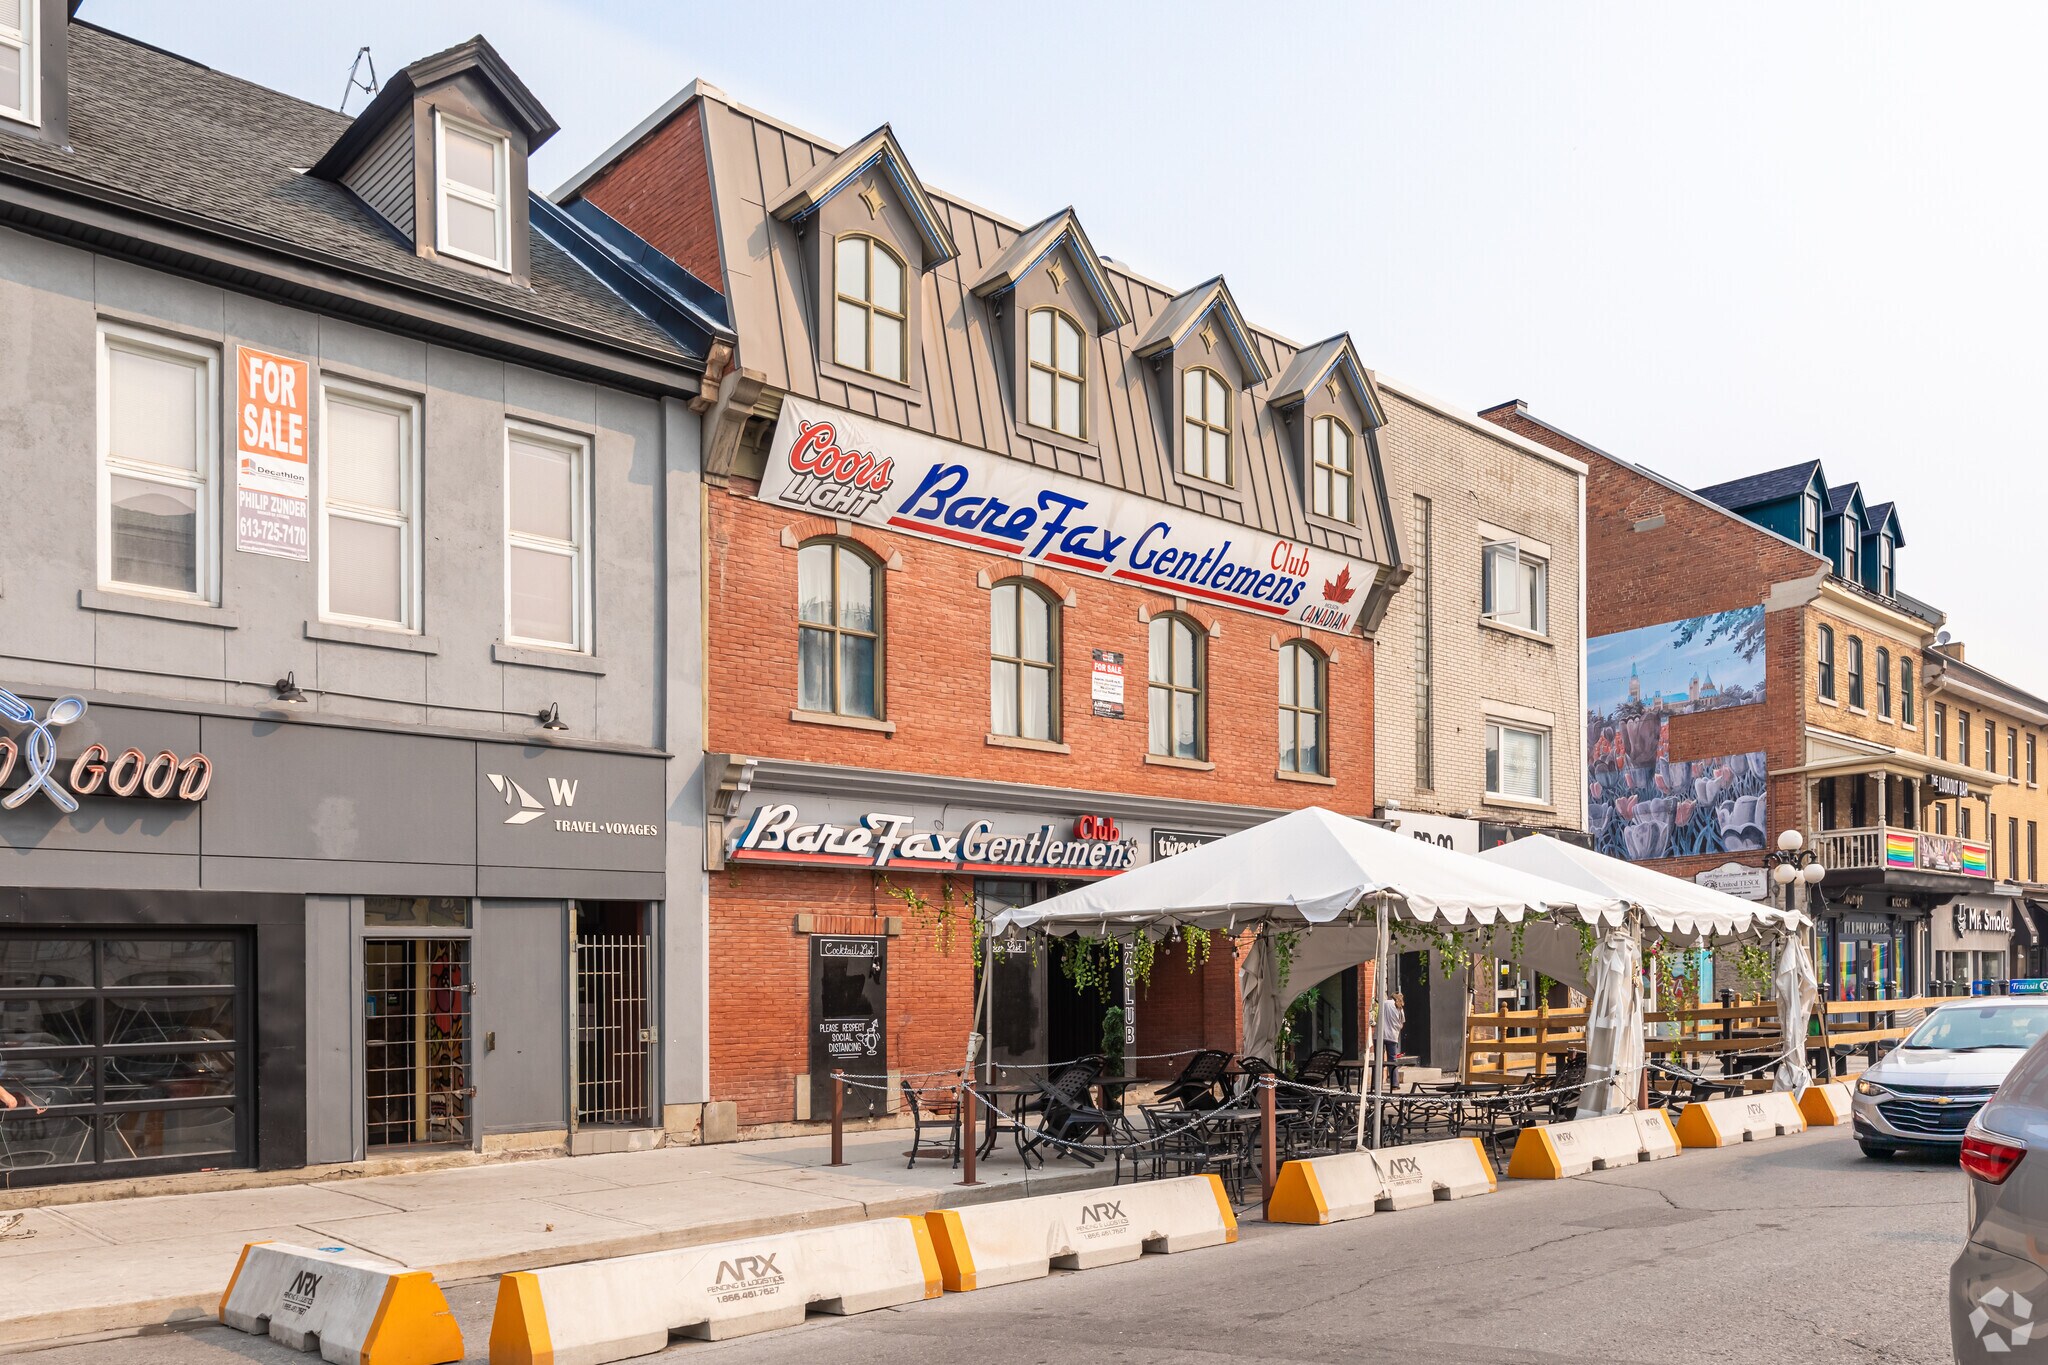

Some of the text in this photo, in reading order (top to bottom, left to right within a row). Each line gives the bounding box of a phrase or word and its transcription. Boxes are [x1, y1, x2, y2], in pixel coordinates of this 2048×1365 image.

[249, 356, 297, 408] FOR
[243, 403, 303, 456] SALE
[788, 419, 896, 491] Coors
[257, 466, 305, 481] Decathlon
[239, 490, 270, 511] PHILIP
[270, 496, 307, 518] ZUNDER
[779, 474, 883, 518] LIGHT
[239, 516, 307, 546] 613-725-7170
[1129, 521, 1307, 606] Gentlemens
[1270, 540, 1310, 578] Club
[1300, 605, 1350, 630] CANADIAN
[1094, 662, 1122, 675] FOR SALE
[70, 743, 213, 801] GOOD
[547, 778, 579, 807] W
[1075, 815, 1120, 842] Club
[1969, 907, 1982, 930] Mr.
[1984, 908, 2010, 931] Smoke
[824, 943, 876, 955] Cocktail List
[2011, 982, 2039, 990] Transit
[820, 1022, 865, 1032] PLEASE RESPECT
[831, 1033, 853, 1042] SOCIAL
[828, 1043, 862, 1053] DISTANCING
[1390, 1157, 1421, 1176] ARX
[1081, 1200, 1127, 1224] ARX
[715, 1252, 782, 1285] ARX
[289, 1270, 323, 1299] ARX
[706, 1282, 739, 1293] FENCING
[747, 1274, 785, 1287] LOGISTICS
